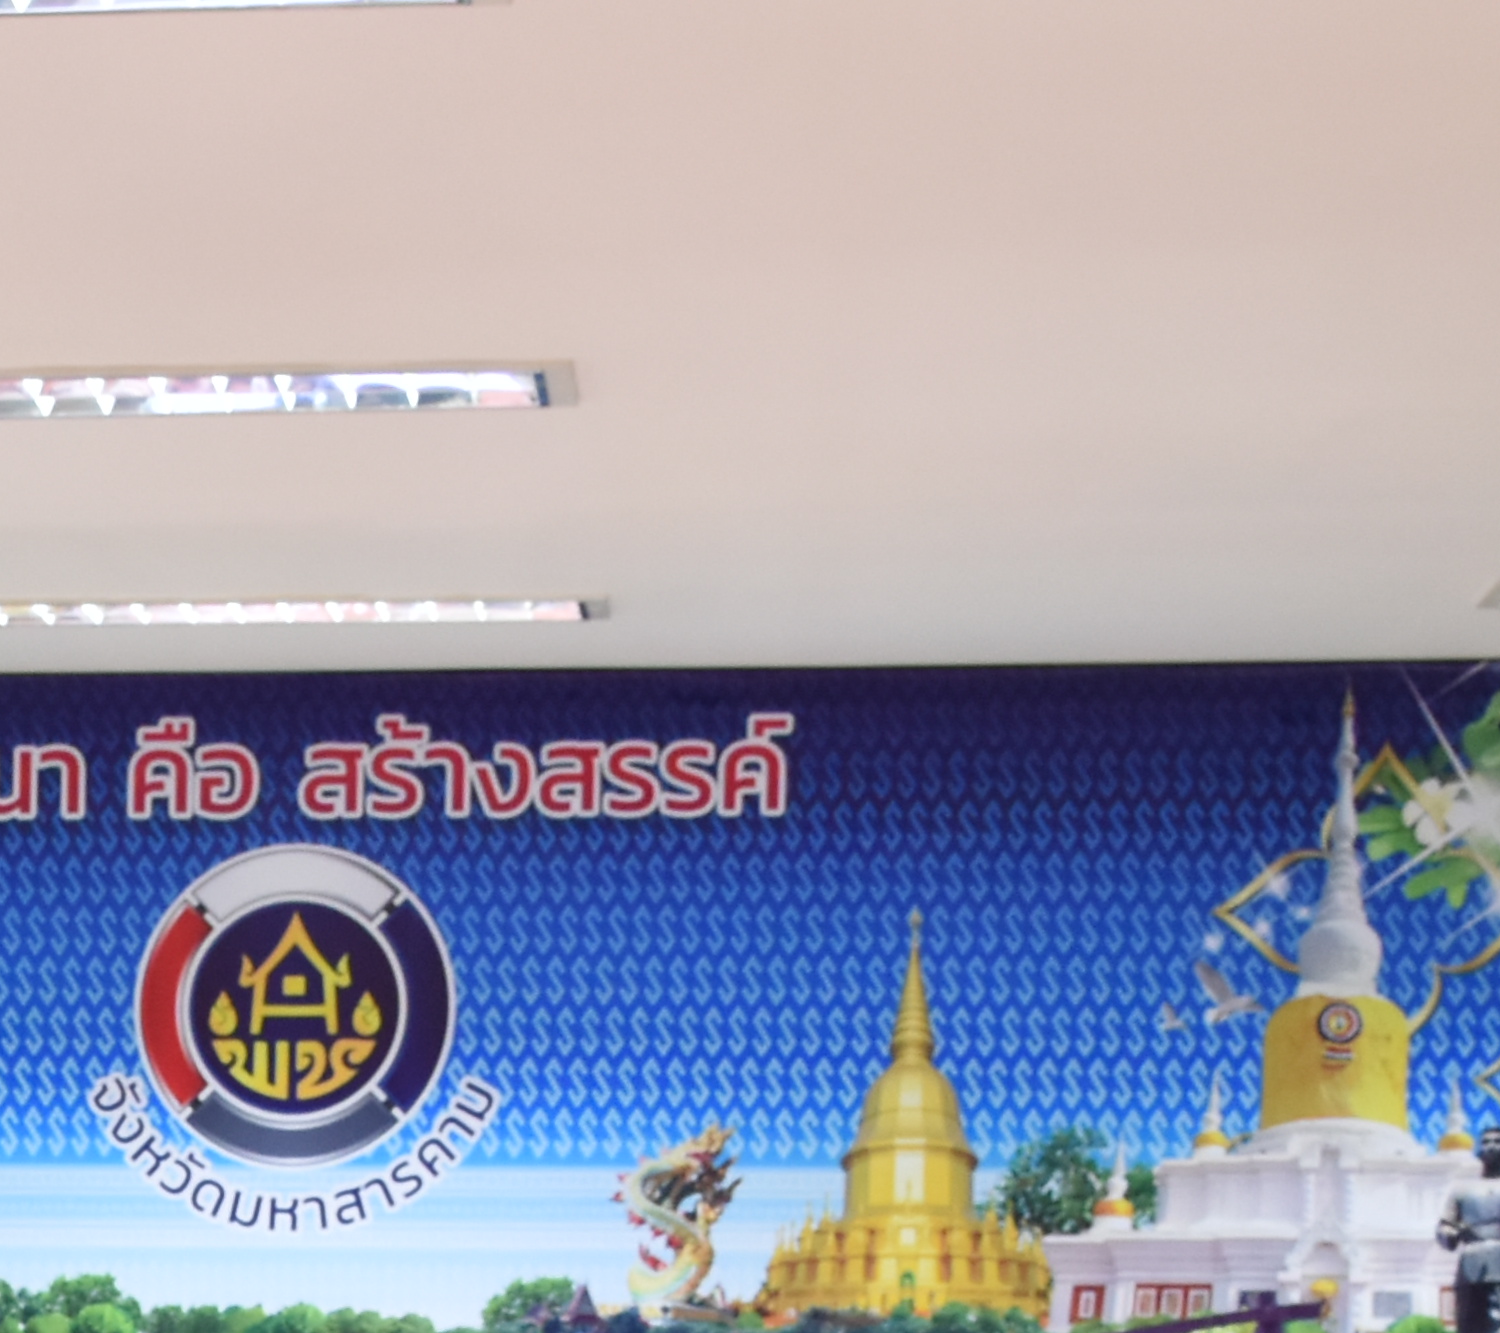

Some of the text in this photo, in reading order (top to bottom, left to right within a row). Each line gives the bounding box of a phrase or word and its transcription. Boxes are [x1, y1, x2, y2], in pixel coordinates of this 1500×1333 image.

[126, 717, 260, 820] คือ
[299, 713, 793, 818] สร้างสรรค์
[94, 1076, 494, 1231] จังหวัดมหาสารคาม
